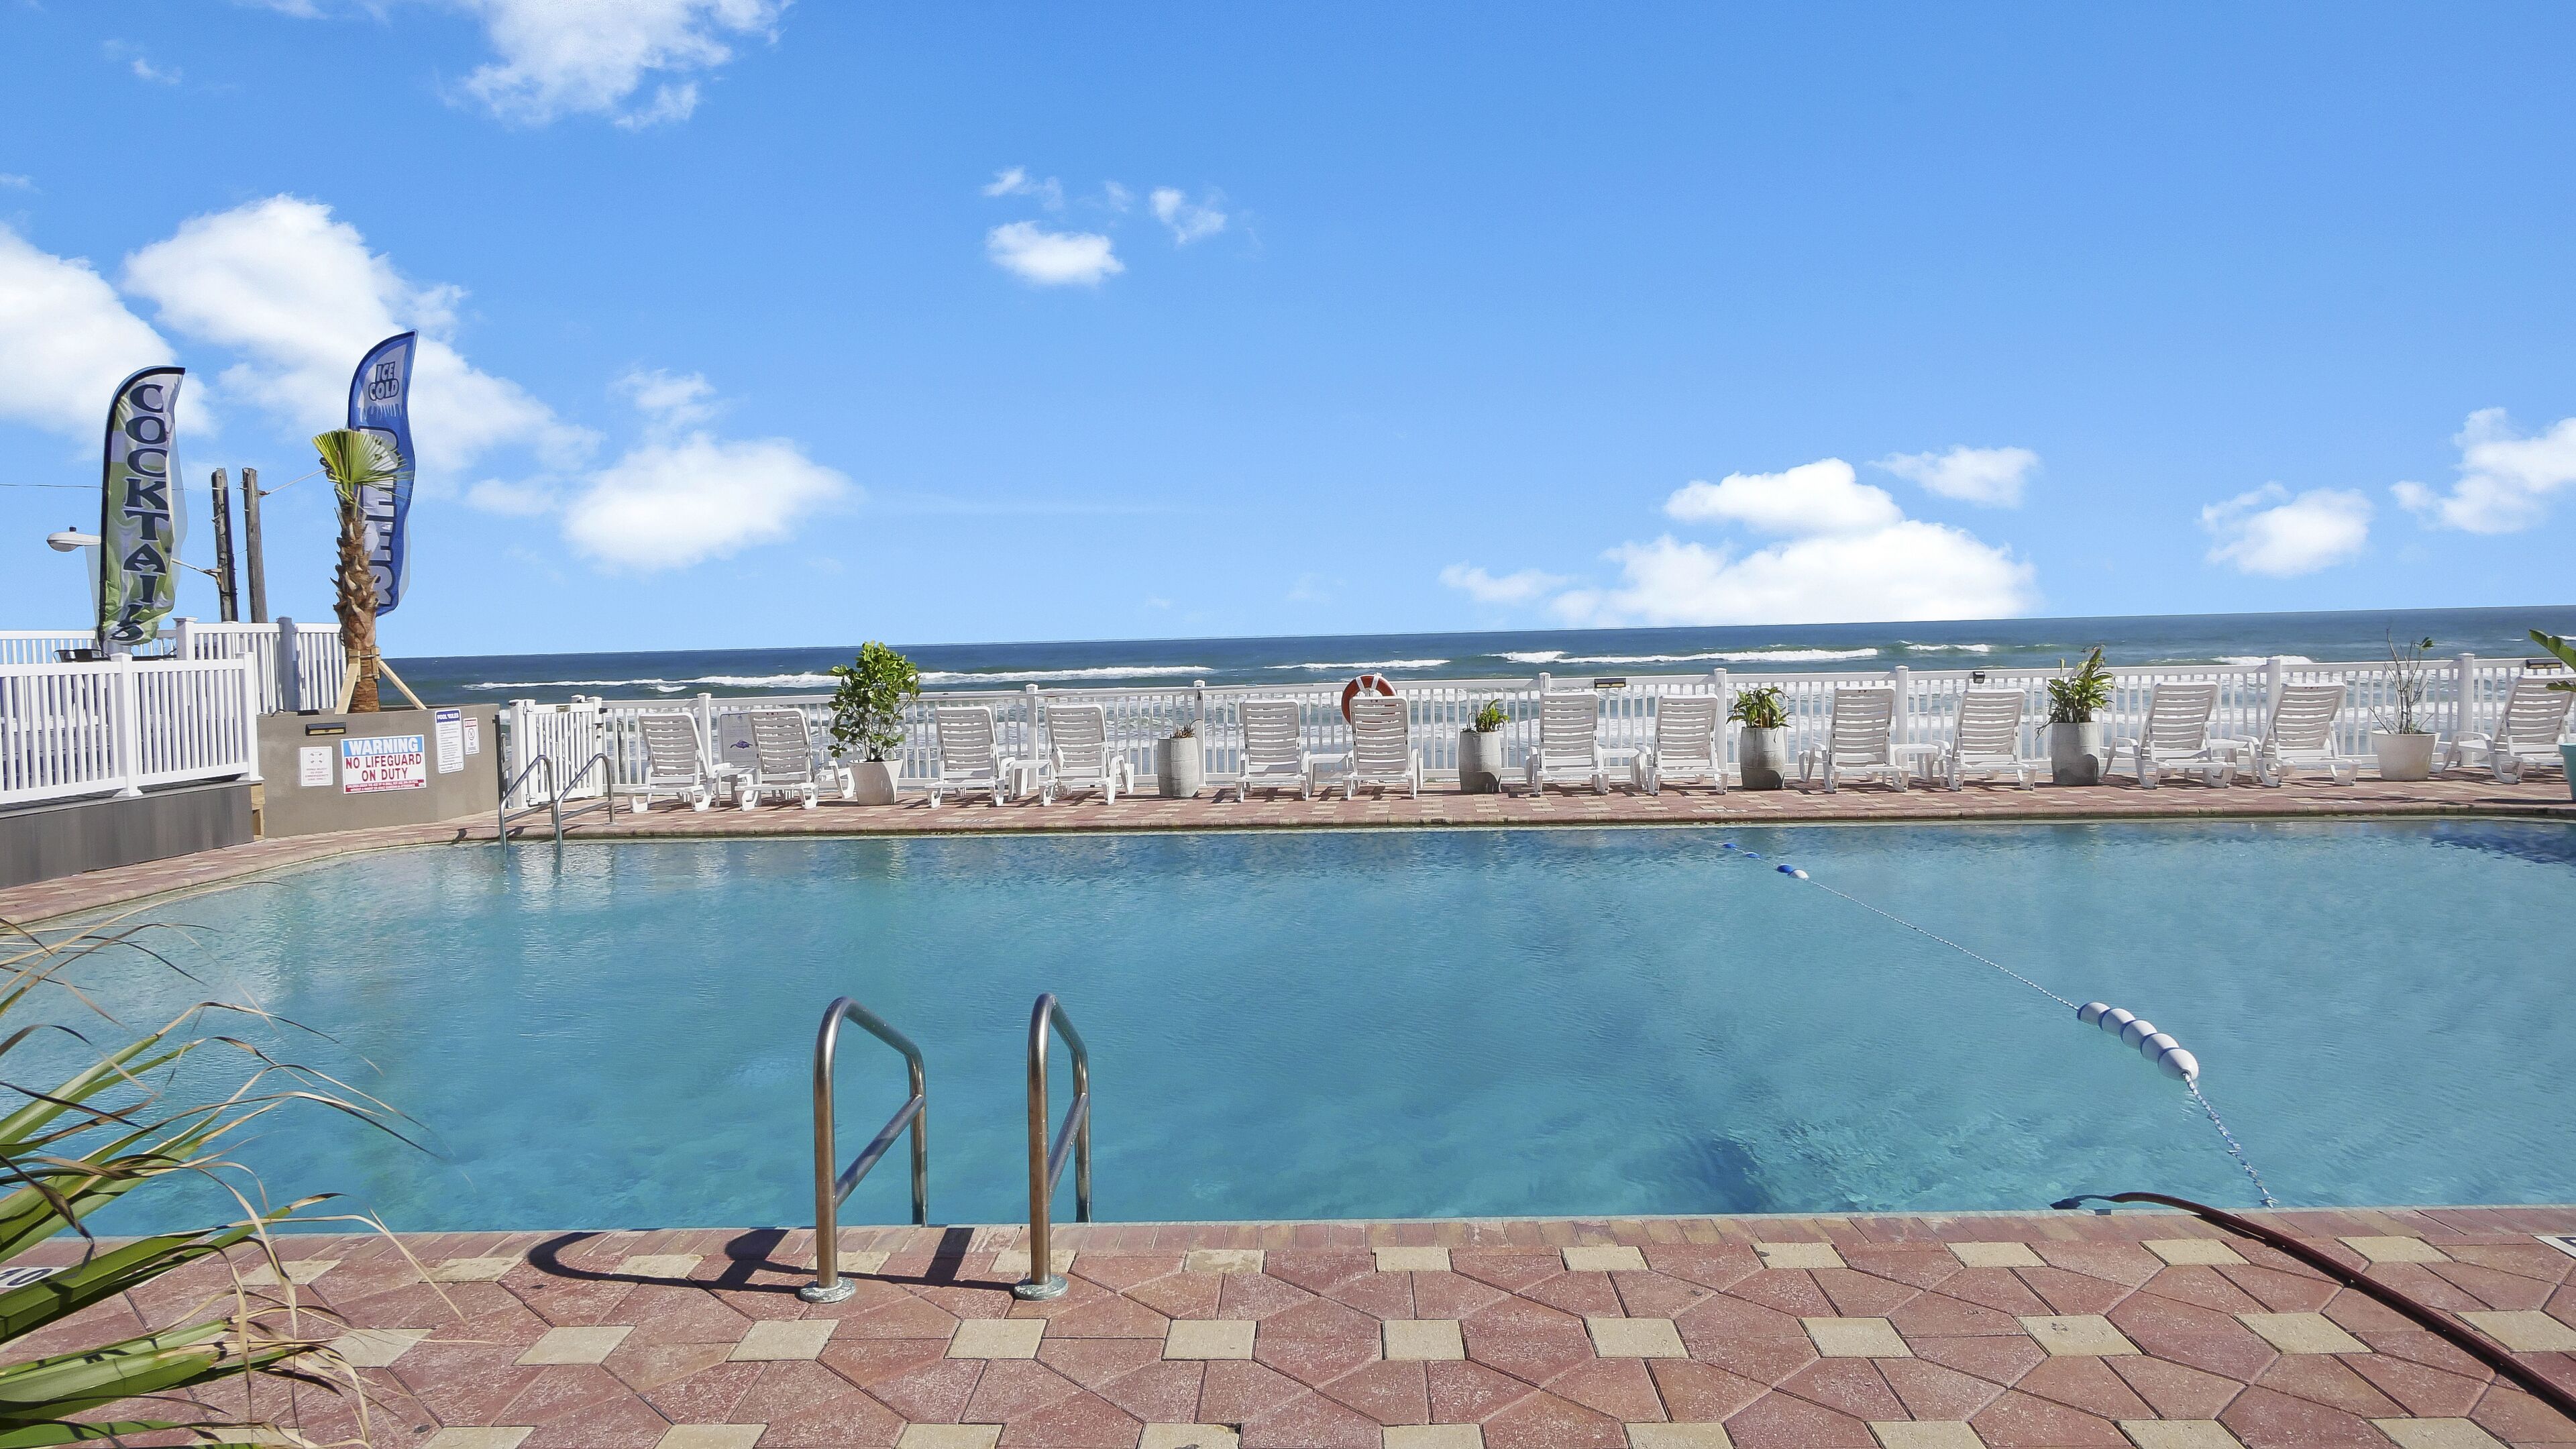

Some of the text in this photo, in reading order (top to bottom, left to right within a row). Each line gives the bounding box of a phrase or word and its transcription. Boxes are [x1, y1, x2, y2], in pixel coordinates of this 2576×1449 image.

[376, 361, 396, 382] ICE
[368, 378, 399, 401] COLD
[348, 737, 419, 756] WARNING
[345, 753, 422, 769] NO LIFEGUARD
[362, 767, 408, 782] ON DUTY
